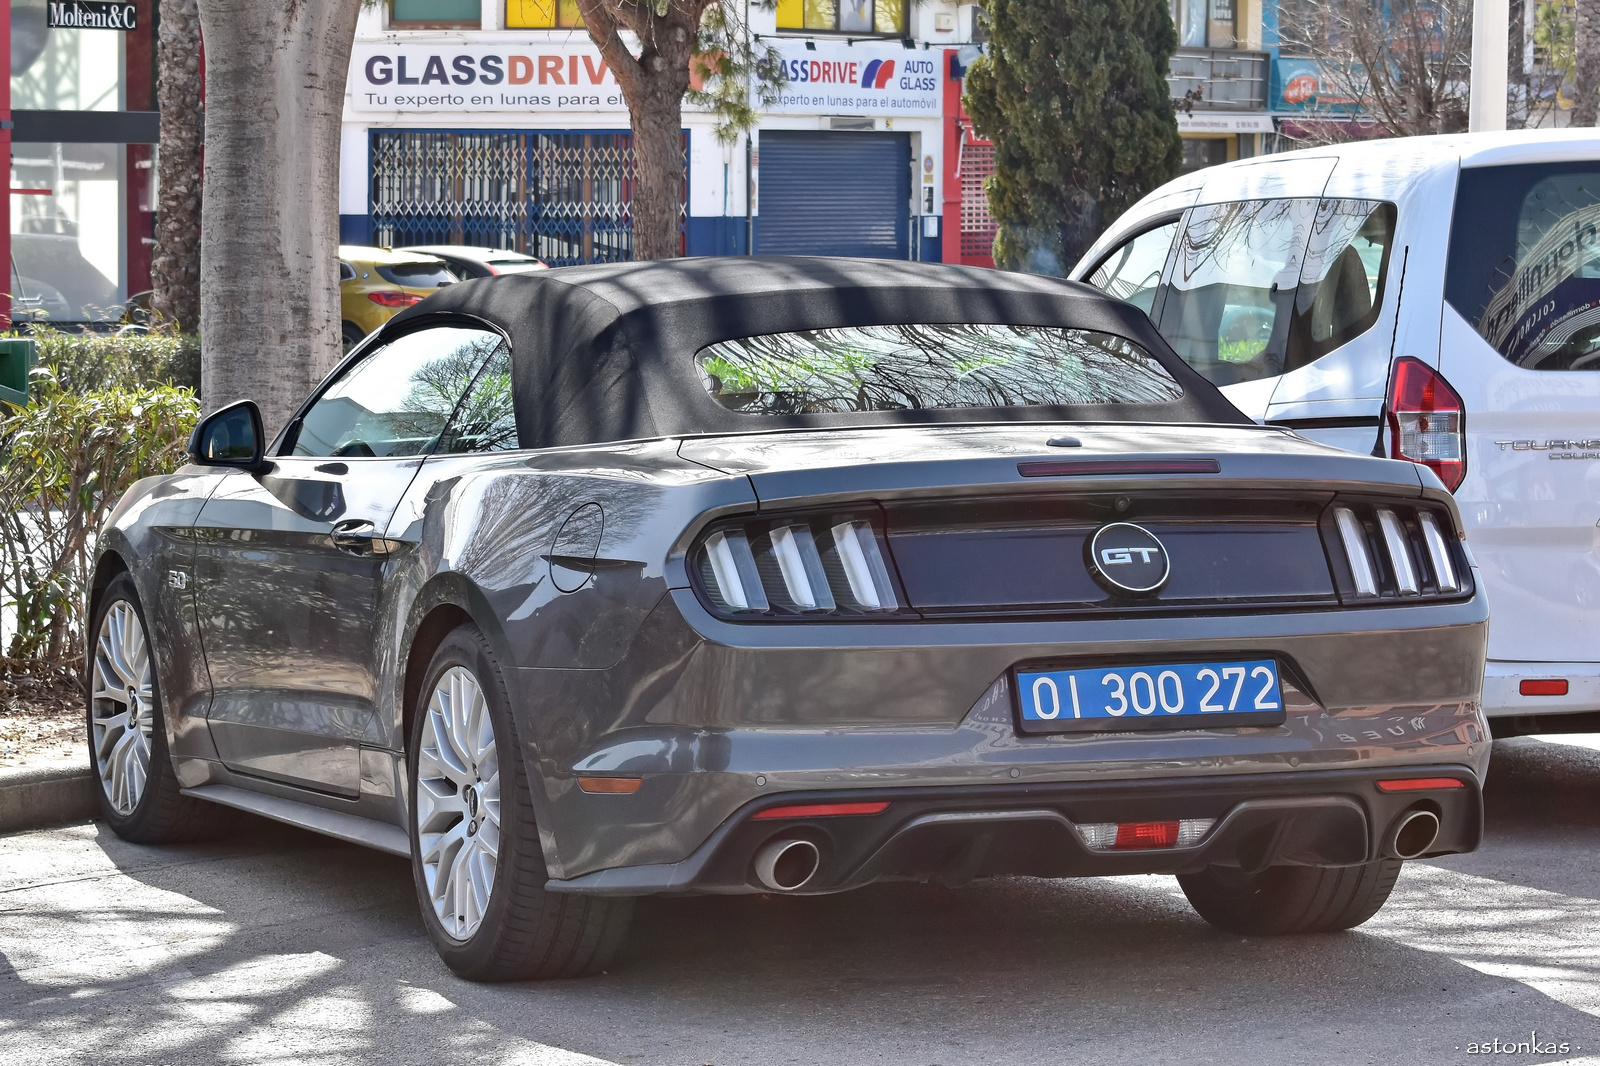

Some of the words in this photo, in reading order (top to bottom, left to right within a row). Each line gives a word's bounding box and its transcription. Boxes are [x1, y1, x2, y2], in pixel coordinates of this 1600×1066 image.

[49, 2, 136, 29] Molteni&C
[365, 55, 639, 86] GLASSDRIV
[757, 58, 858, 84] GASSDRIVE
[904, 60, 934, 74] AUTO
[900, 77, 936, 91] GLASS
[365, 93, 388, 105] Tu
[394, 93, 464, 107] experto
[471, 95, 493, 105] en
[500, 94, 551, 105] lunas
[558, 96, 600, 107] para
[607, 94, 622, 105] el
[772, 94, 810, 108] experto
[812, 96, 825, 106] en
[827, 95, 854, 107] lunas
[856, 97, 878, 109] para
[880, 96, 889, 108] el
[890, 97, 937, 109] automóvil
[1101, 547, 1159, 565] GT
[1101, 670, 1185, 717] 300
[1196, 665, 1279, 712] 272
